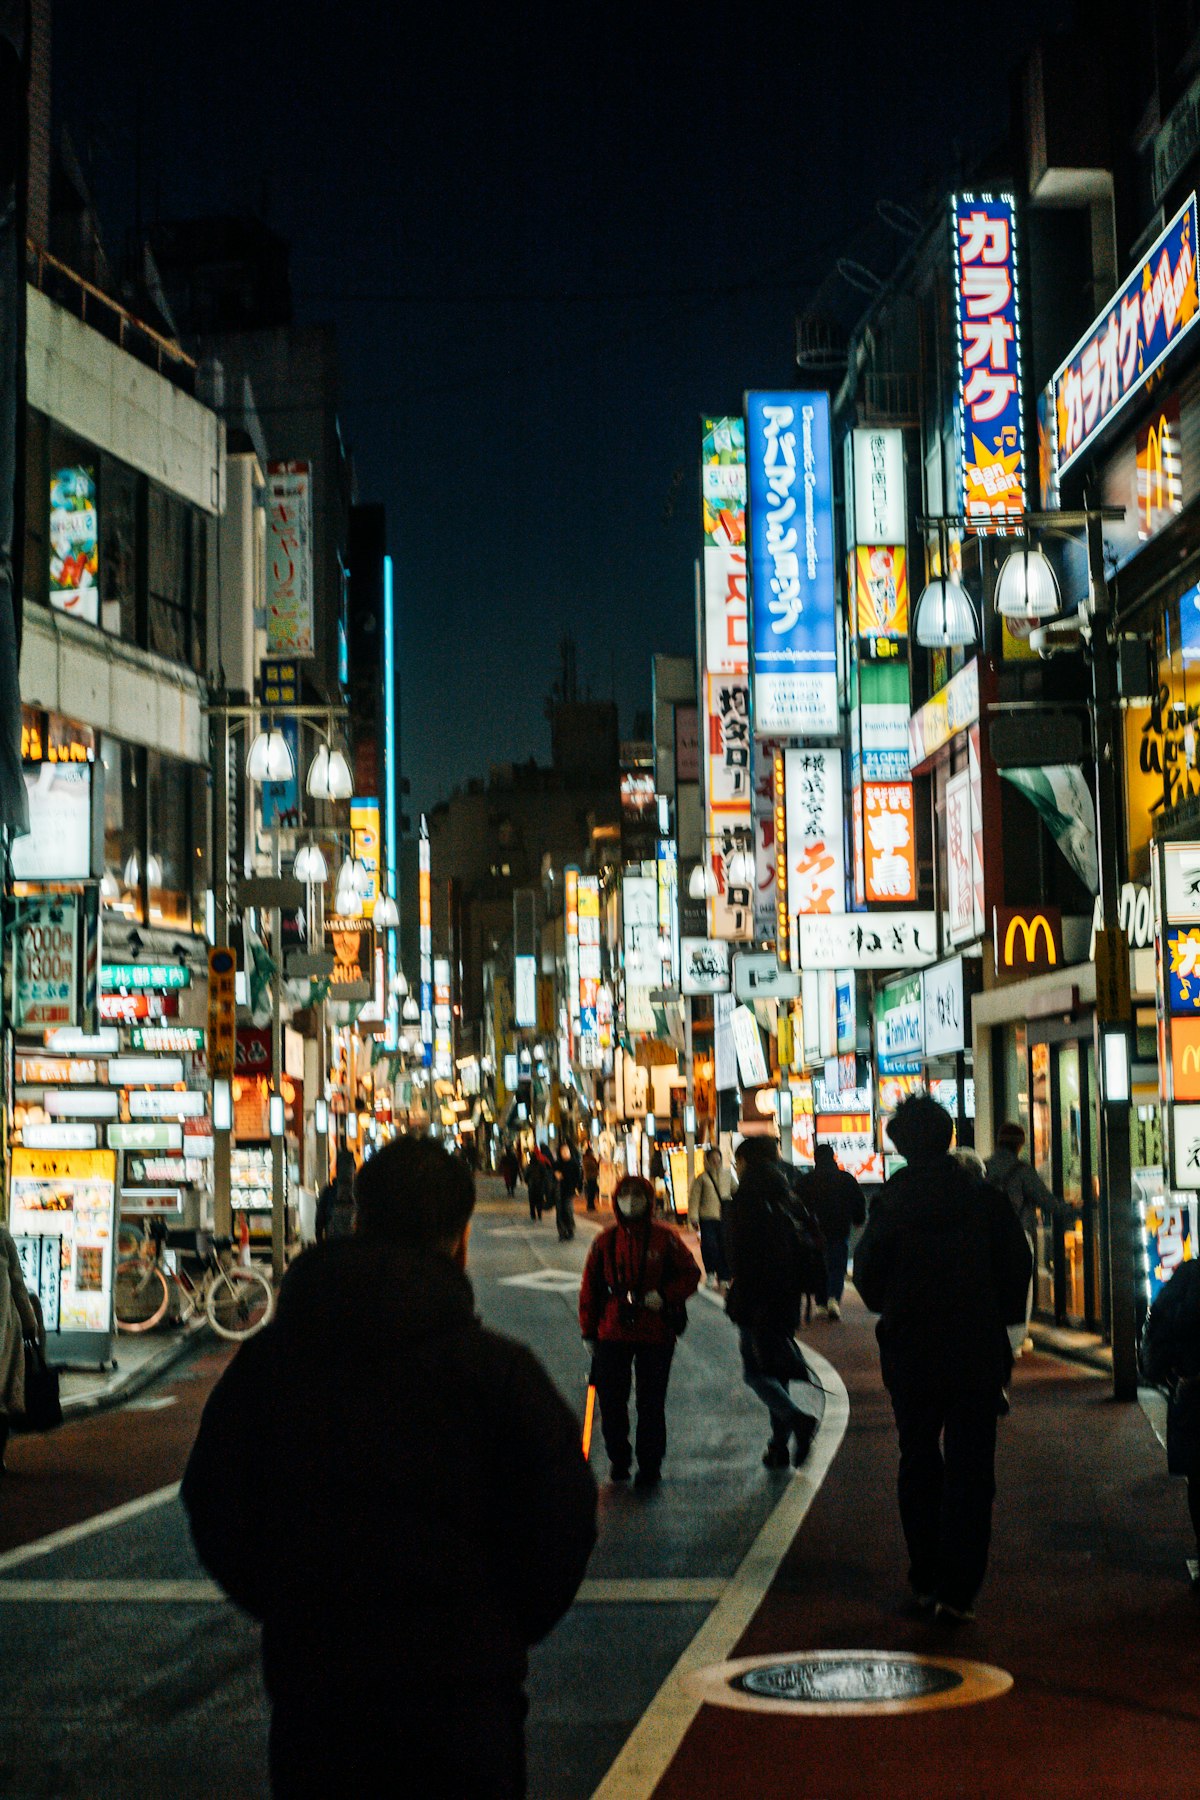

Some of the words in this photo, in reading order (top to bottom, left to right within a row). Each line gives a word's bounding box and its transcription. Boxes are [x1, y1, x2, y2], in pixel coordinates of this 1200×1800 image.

[959, 211, 1016, 423] カラオケ
[1142, 247, 1173, 347] Ban
[1162, 239, 1192, 341] Ban
[1064, 291, 1140, 458] カラオケ
[762, 405, 803, 635] アパマンショップ
[969, 462, 1005, 487] Ban
[982, 473, 1018, 497] Ban
[847, 923, 938, 954] ねぎし
